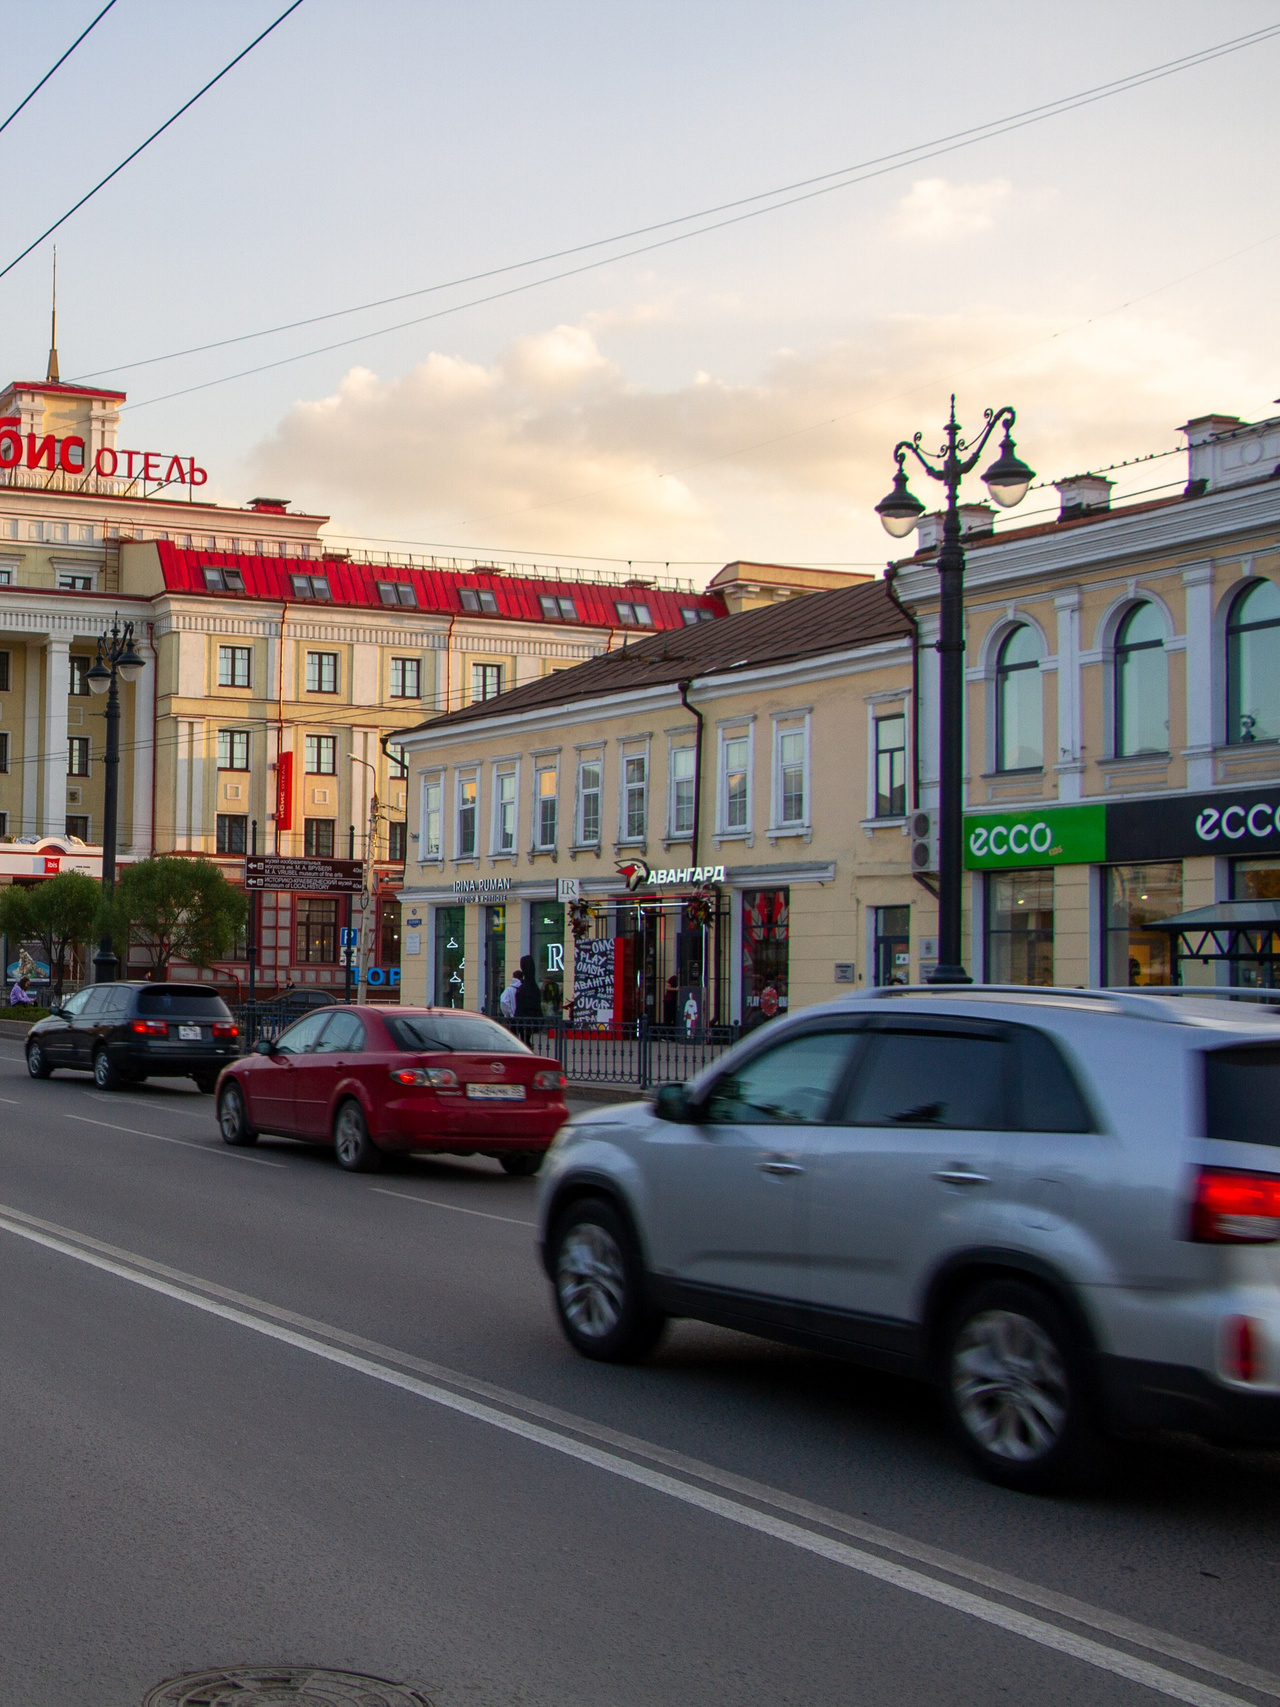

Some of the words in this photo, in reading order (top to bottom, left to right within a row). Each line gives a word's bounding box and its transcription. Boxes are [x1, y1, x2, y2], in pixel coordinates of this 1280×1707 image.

[95, 447, 208, 486] ОТЕЛЬ
[1195, 802, 1280, 842] ecc
[970, 822, 1053, 857] ecco
[47, 861, 58, 869] ibis
[647, 865, 726, 885] АВАНГАРД
[454, 880, 477, 892] IRINA
[479, 878, 512, 891] RUMAN
[580, 951, 607, 966] PLAY
